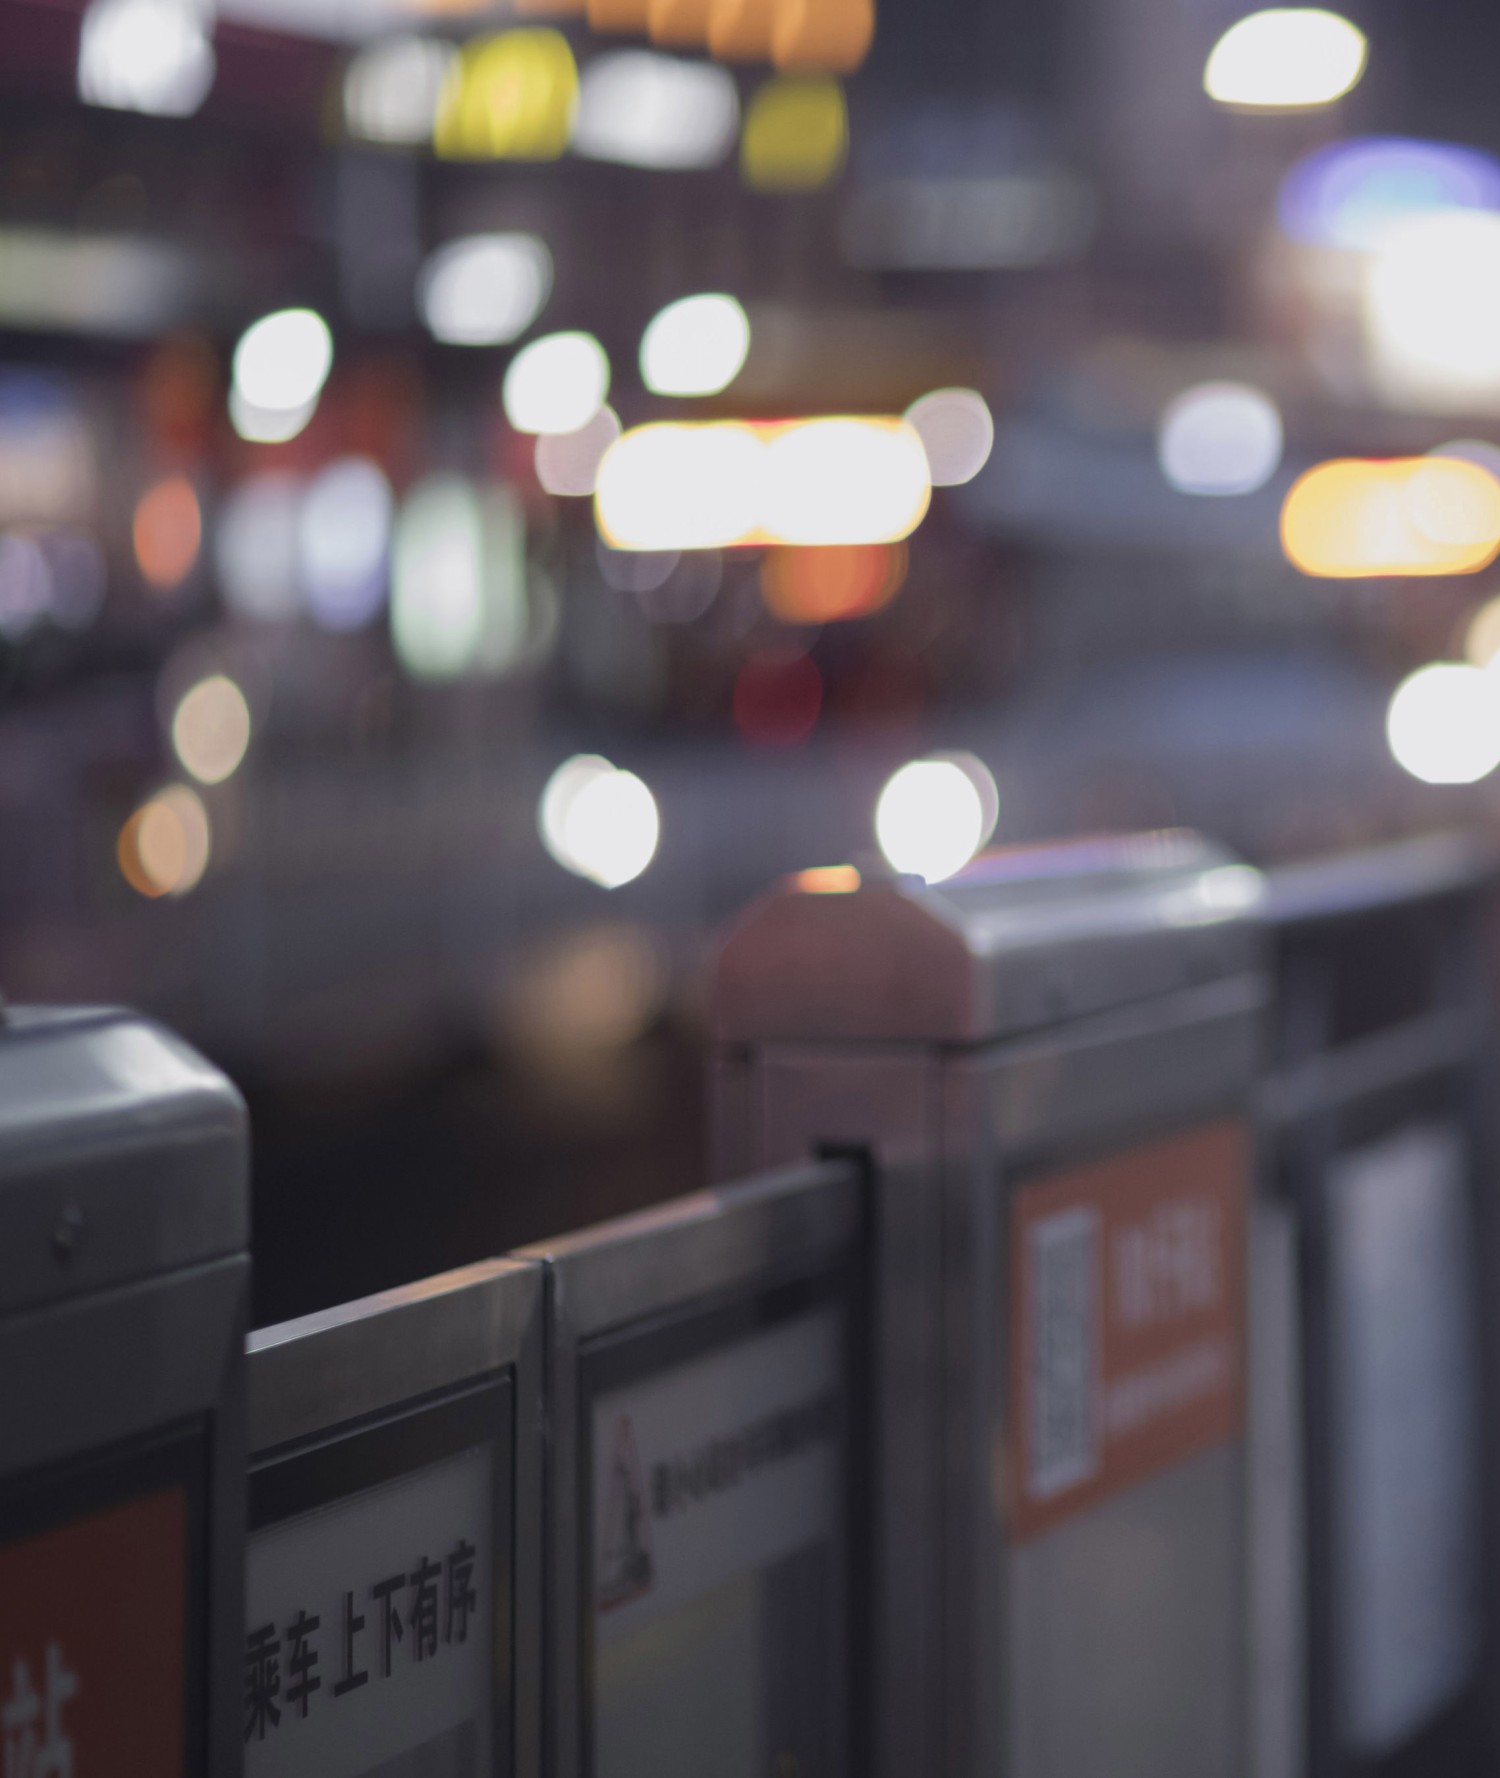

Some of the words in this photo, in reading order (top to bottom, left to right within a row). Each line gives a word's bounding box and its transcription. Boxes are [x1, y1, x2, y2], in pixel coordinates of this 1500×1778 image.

[244, 1539, 477, 1742] 乘车上下有序
